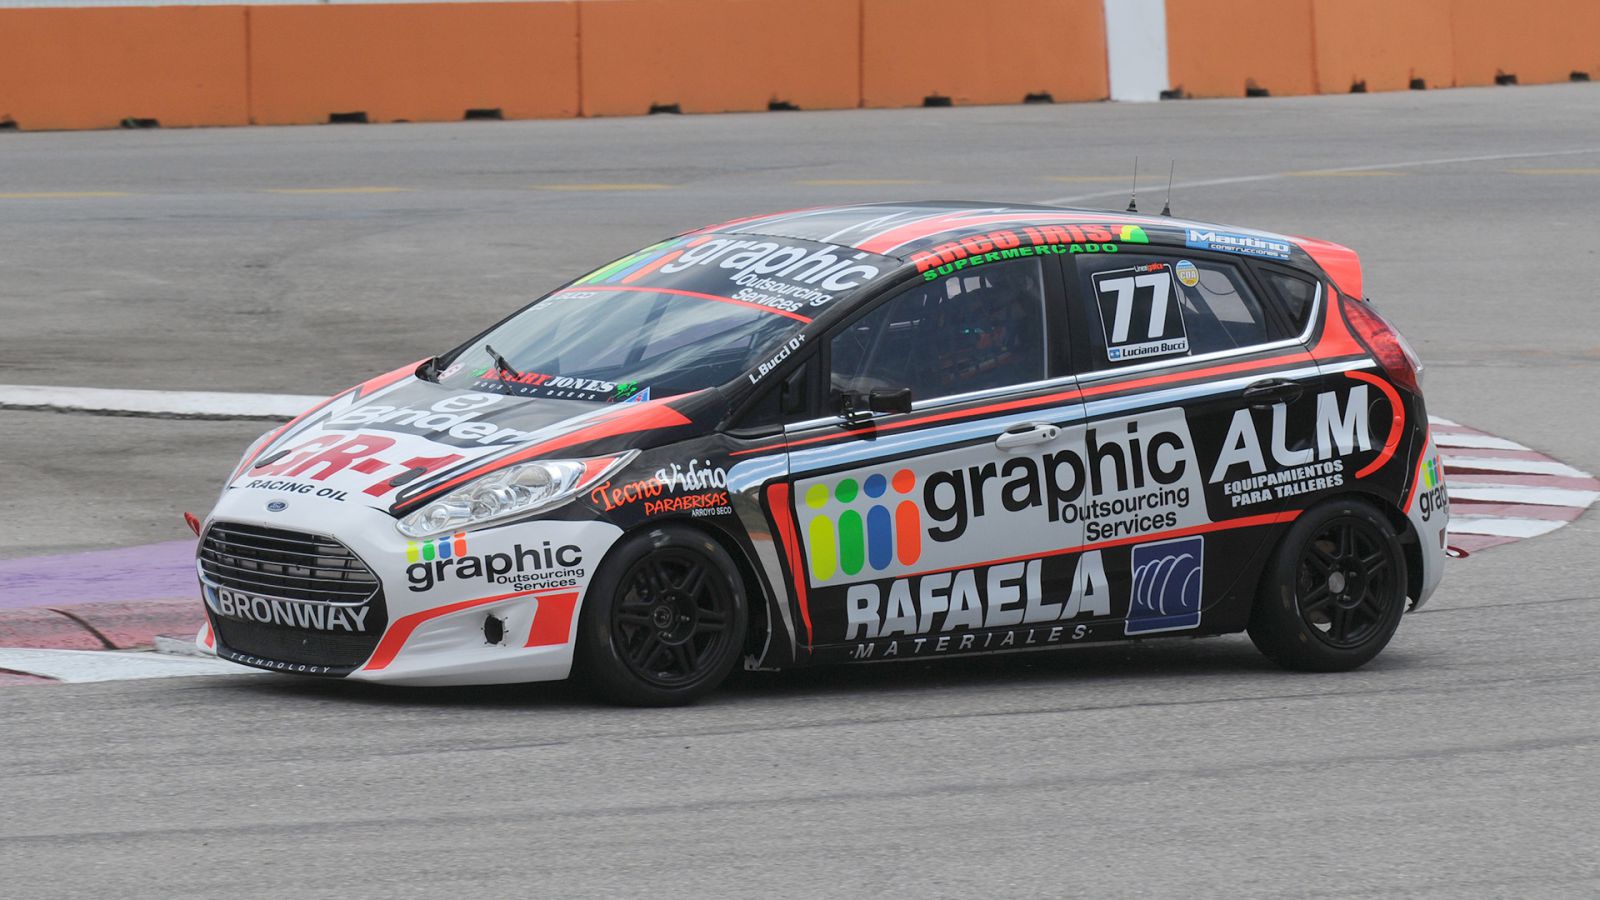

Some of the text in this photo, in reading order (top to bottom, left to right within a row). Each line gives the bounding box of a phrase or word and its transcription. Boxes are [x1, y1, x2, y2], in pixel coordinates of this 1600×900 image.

[659, 238, 880, 291] graphic
[910, 224, 1112, 273] ARCO IRIS
[923, 243, 1118, 281] SUPERMERCADO
[731, 288, 803, 313] Services
[1099, 272, 1171, 344] 77
[1122, 340, 1186, 357] Luciano Bucci
[544, 376, 618, 393] JONES
[1208, 384, 1372, 485] ALM
[248, 434, 465, 497] GR-1
[922, 421, 1186, 543] graphic
[1224, 459, 1344, 495] EQUIPAMIENTOS
[246, 479, 349, 501] RACING OIL
[644, 491, 728, 516] PARABRISAS
[1062, 486, 1190, 524] Outsourcing
[1231, 473, 1344, 508] PARA TALLERES
[691, 506, 732, 517] ARROYO SECO
[1086, 510, 1177, 542] Services
[405, 541, 583, 592] graphic
[496, 566, 585, 585] Outsourcing
[513, 578, 577, 592] Services
[844, 549, 1110, 640] RAFAELA
[218, 588, 370, 632] BRONWAY
[230, 652, 331, 673] TECHNOLOGY
